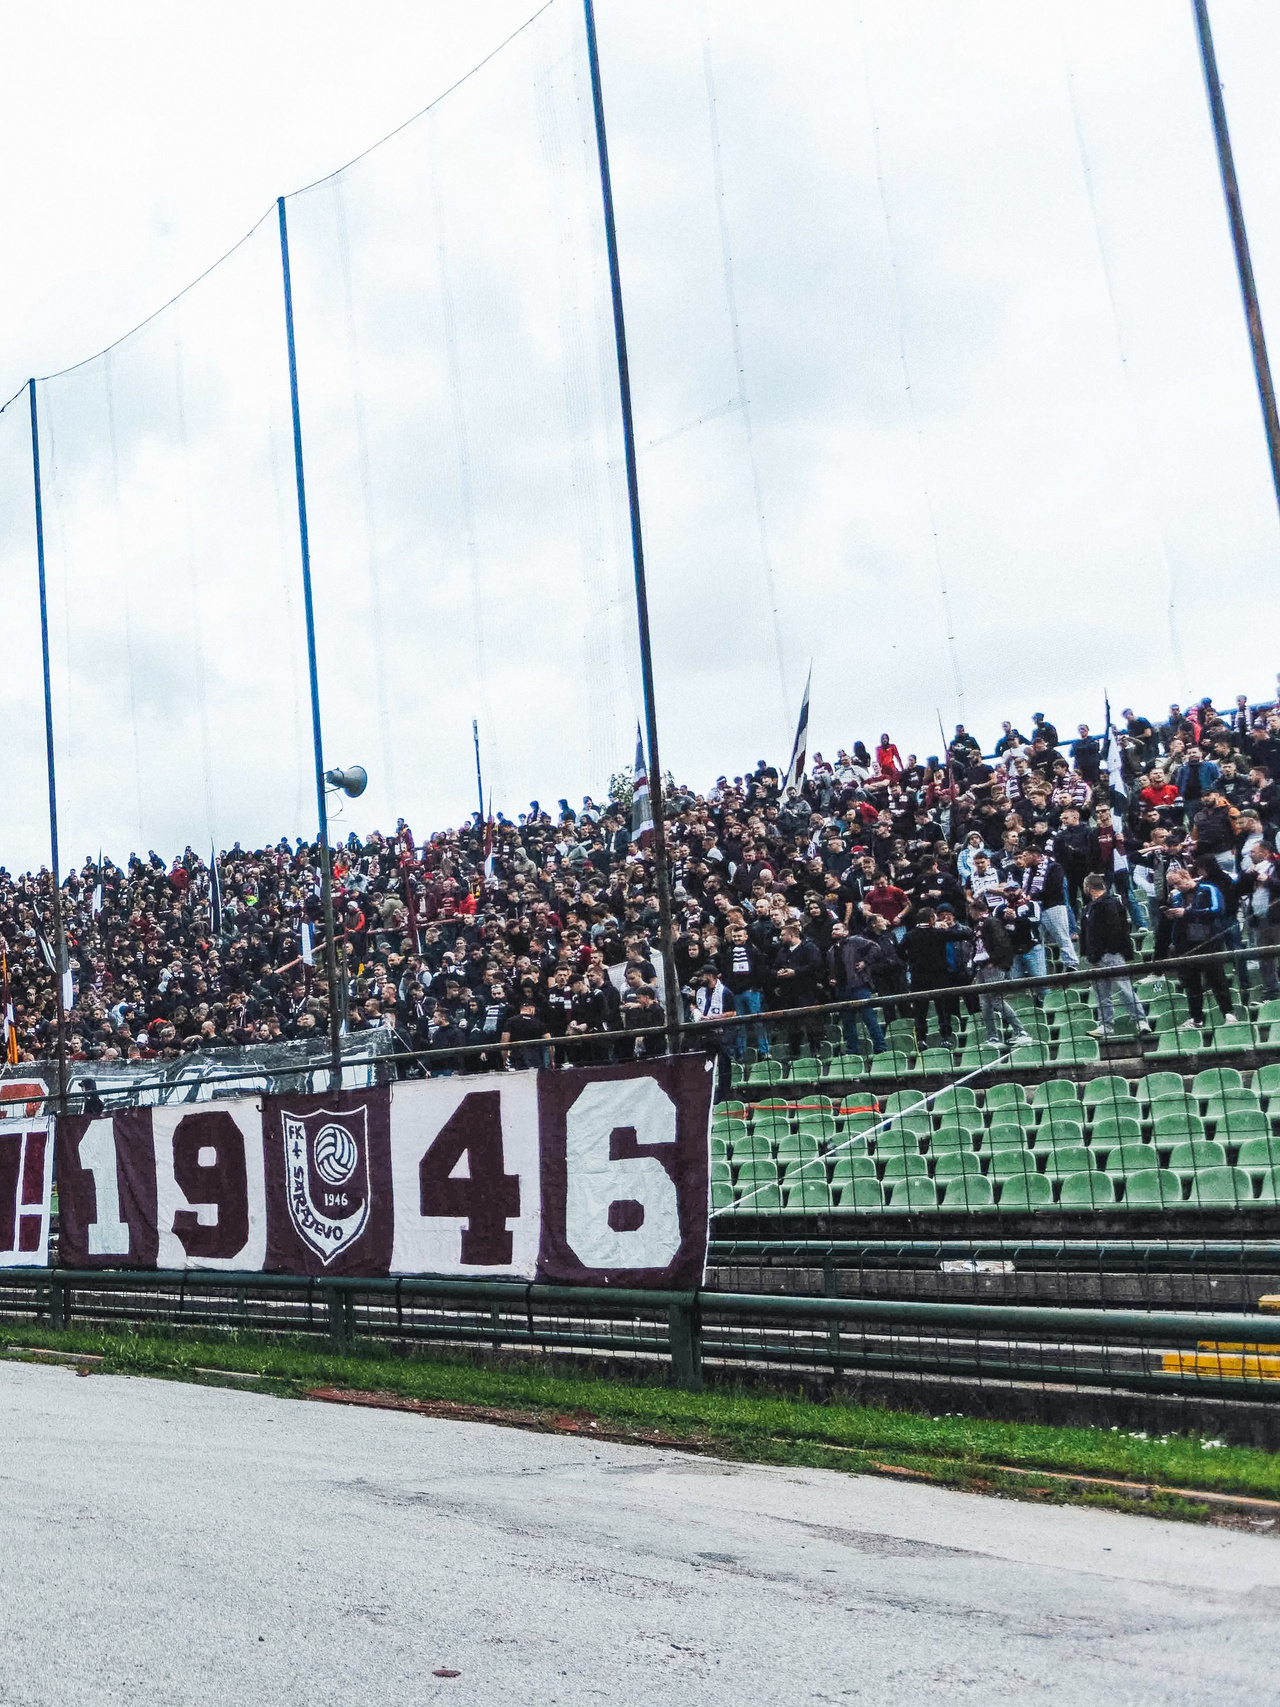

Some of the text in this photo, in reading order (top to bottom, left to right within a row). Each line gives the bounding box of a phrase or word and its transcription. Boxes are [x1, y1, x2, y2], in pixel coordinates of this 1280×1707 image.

[288, 1124, 305, 1141] FK
[292, 1165, 344, 1242] SARAJEVO
[324, 1192, 348, 1207] 1946
